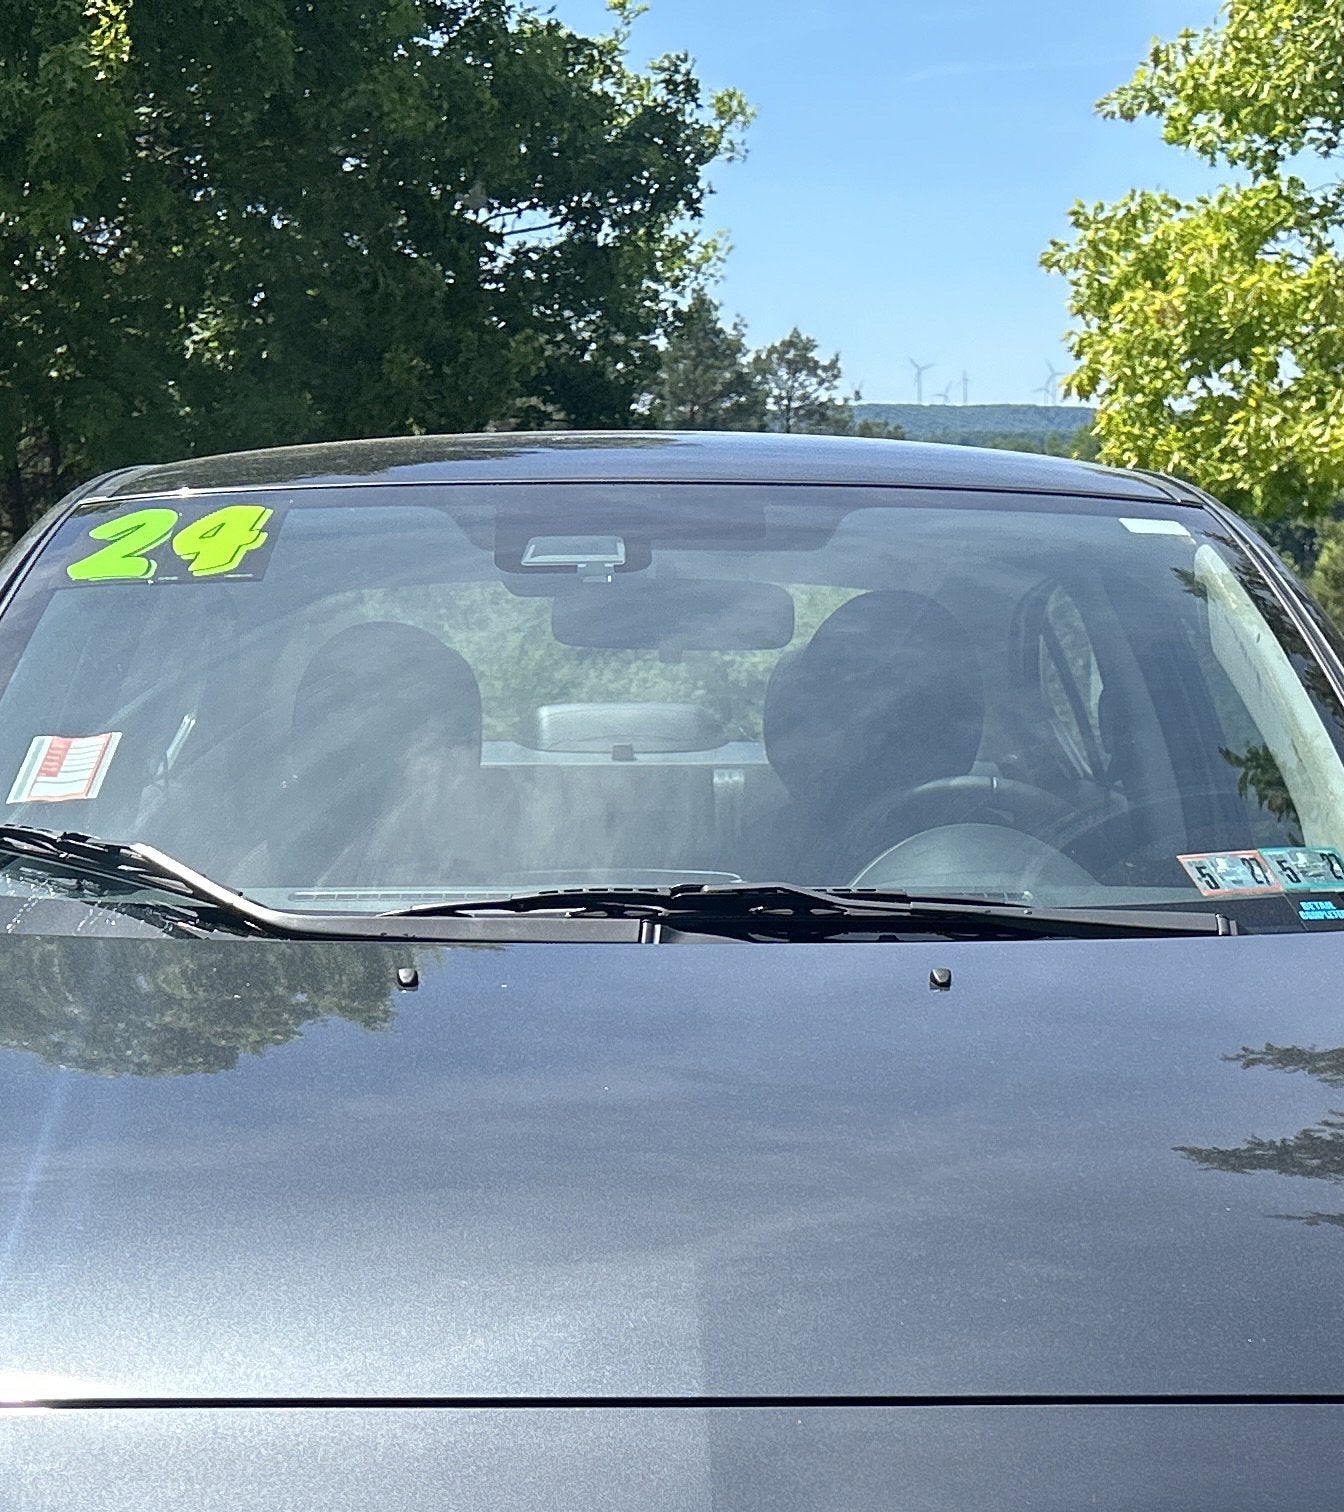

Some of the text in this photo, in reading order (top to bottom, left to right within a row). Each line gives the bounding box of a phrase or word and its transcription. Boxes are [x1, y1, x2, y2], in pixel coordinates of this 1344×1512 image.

[67, 505, 274, 581] 24
[1195, 857, 1271, 890] 5 27
[1275, 859, 1302, 884] 5
[1299, 901, 1337, 910] DETAIL
